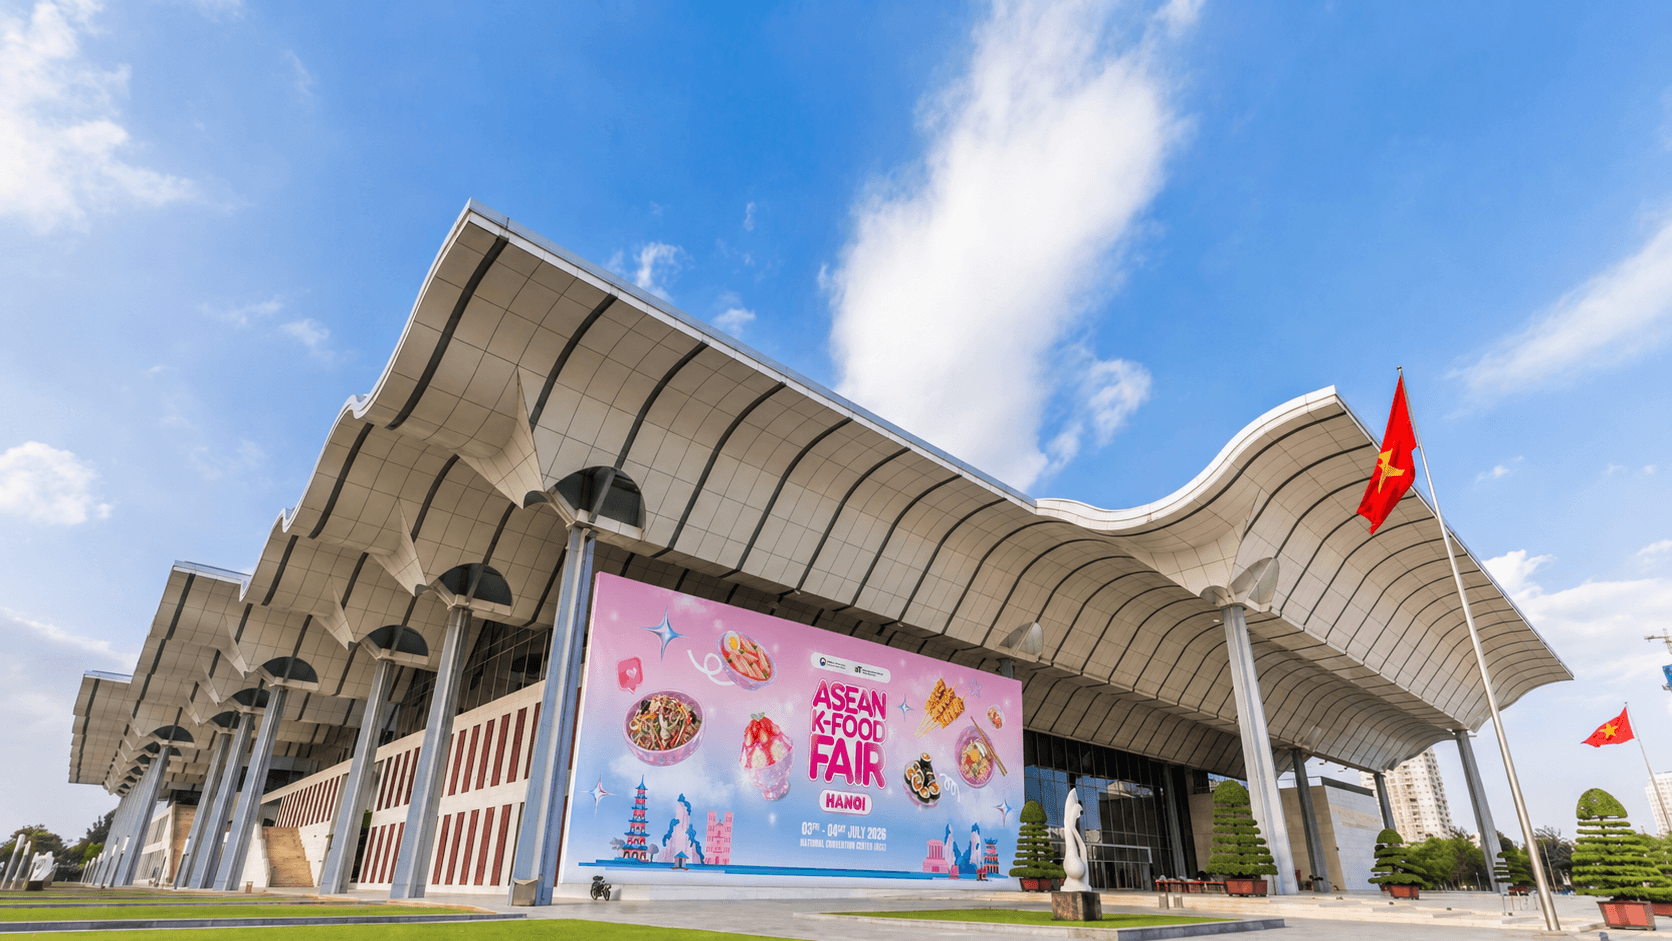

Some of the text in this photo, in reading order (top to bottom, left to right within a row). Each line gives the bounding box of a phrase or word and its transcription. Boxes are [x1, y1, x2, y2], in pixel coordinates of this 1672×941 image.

[812, 680, 886, 720] ASEAN
[812, 709, 886, 742] K-FOOD
[809, 734, 886, 788] FAIR
[826, 792, 866, 812] HANOI
[800, 838, 824, 848] NATIONAL
[848, 825, 866, 839] JULY
[867, 826, 886, 840] 2026
